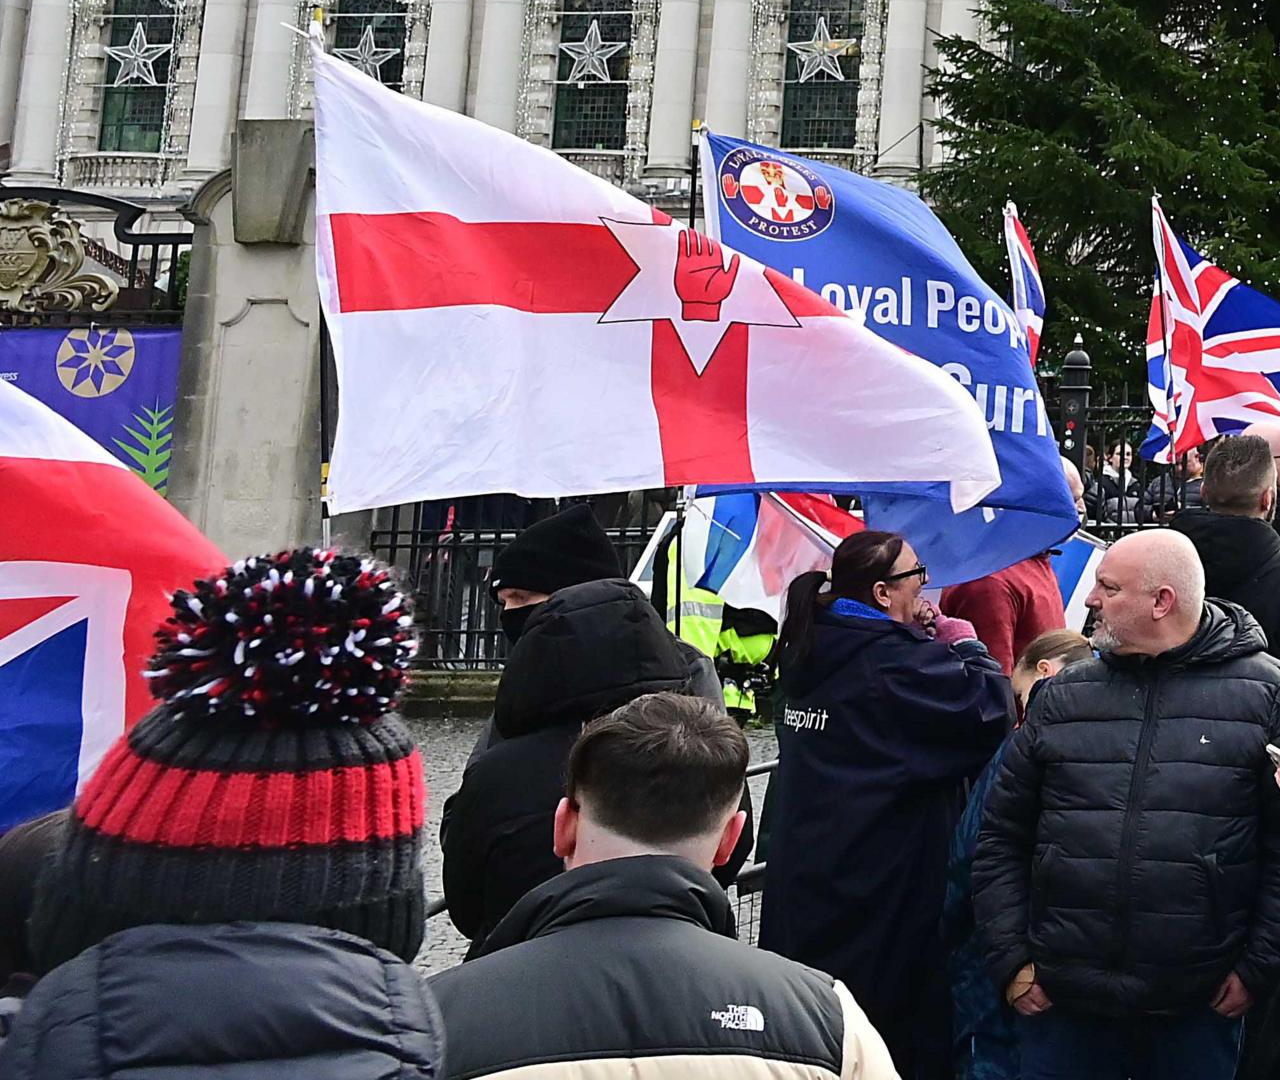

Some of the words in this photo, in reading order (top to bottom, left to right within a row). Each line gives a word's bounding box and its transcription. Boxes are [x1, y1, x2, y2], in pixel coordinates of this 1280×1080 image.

[749, 216, 818, 236] PROTEST
[792, 268, 912, 326] oyal
[727, 1005, 748, 1013] THE
[711, 1011, 748, 1021] NORTH
[721, 1020, 748, 1030] FACE
